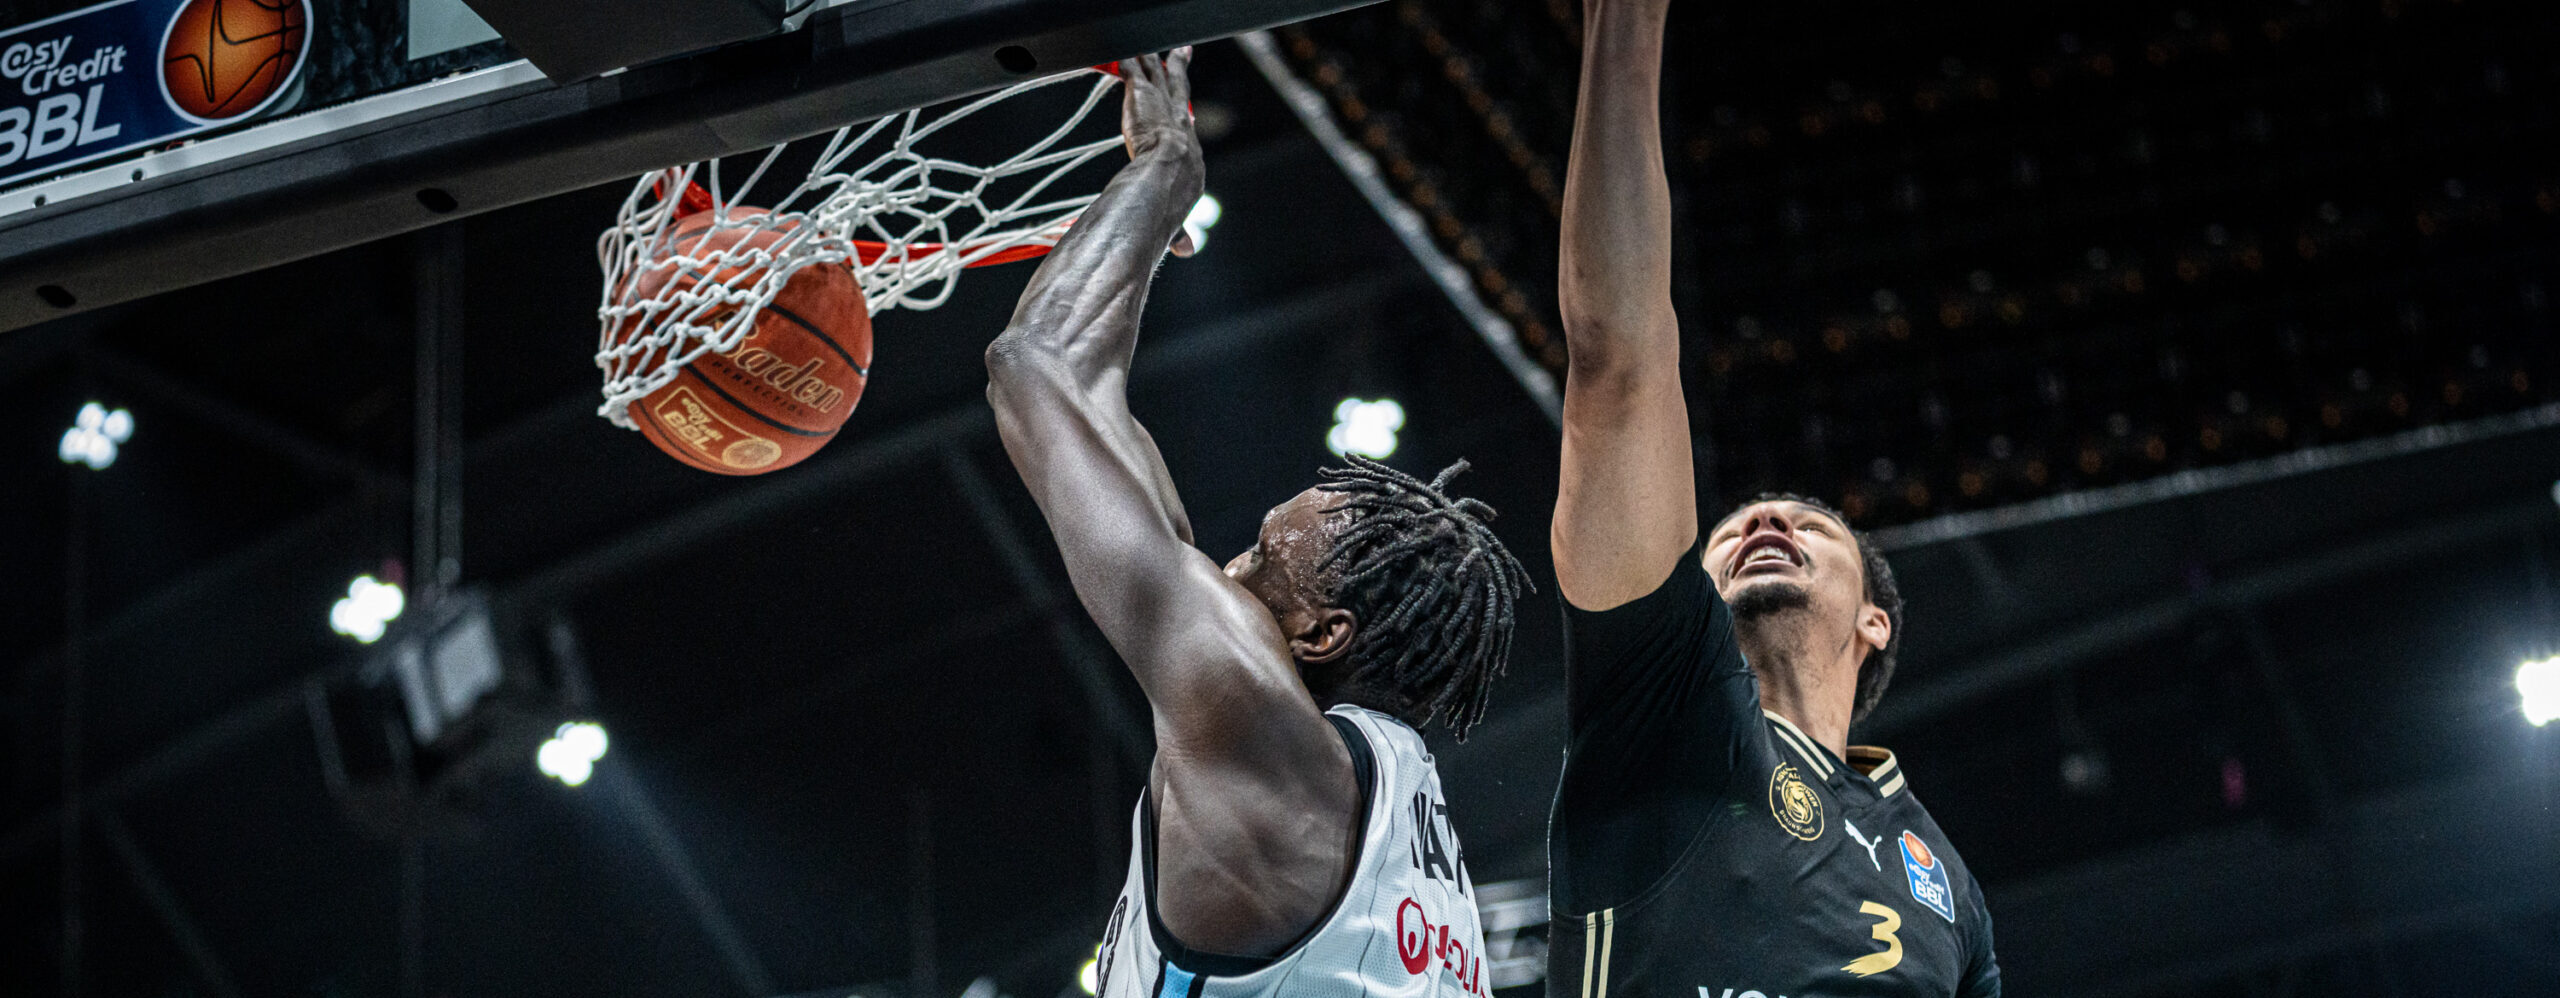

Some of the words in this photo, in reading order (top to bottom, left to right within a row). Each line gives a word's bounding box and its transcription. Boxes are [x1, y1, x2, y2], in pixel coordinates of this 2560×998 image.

[22, 45, 127, 96] Credit
[1914, 879, 1949, 913] BBL
[1840, 900, 1903, 978] 3
